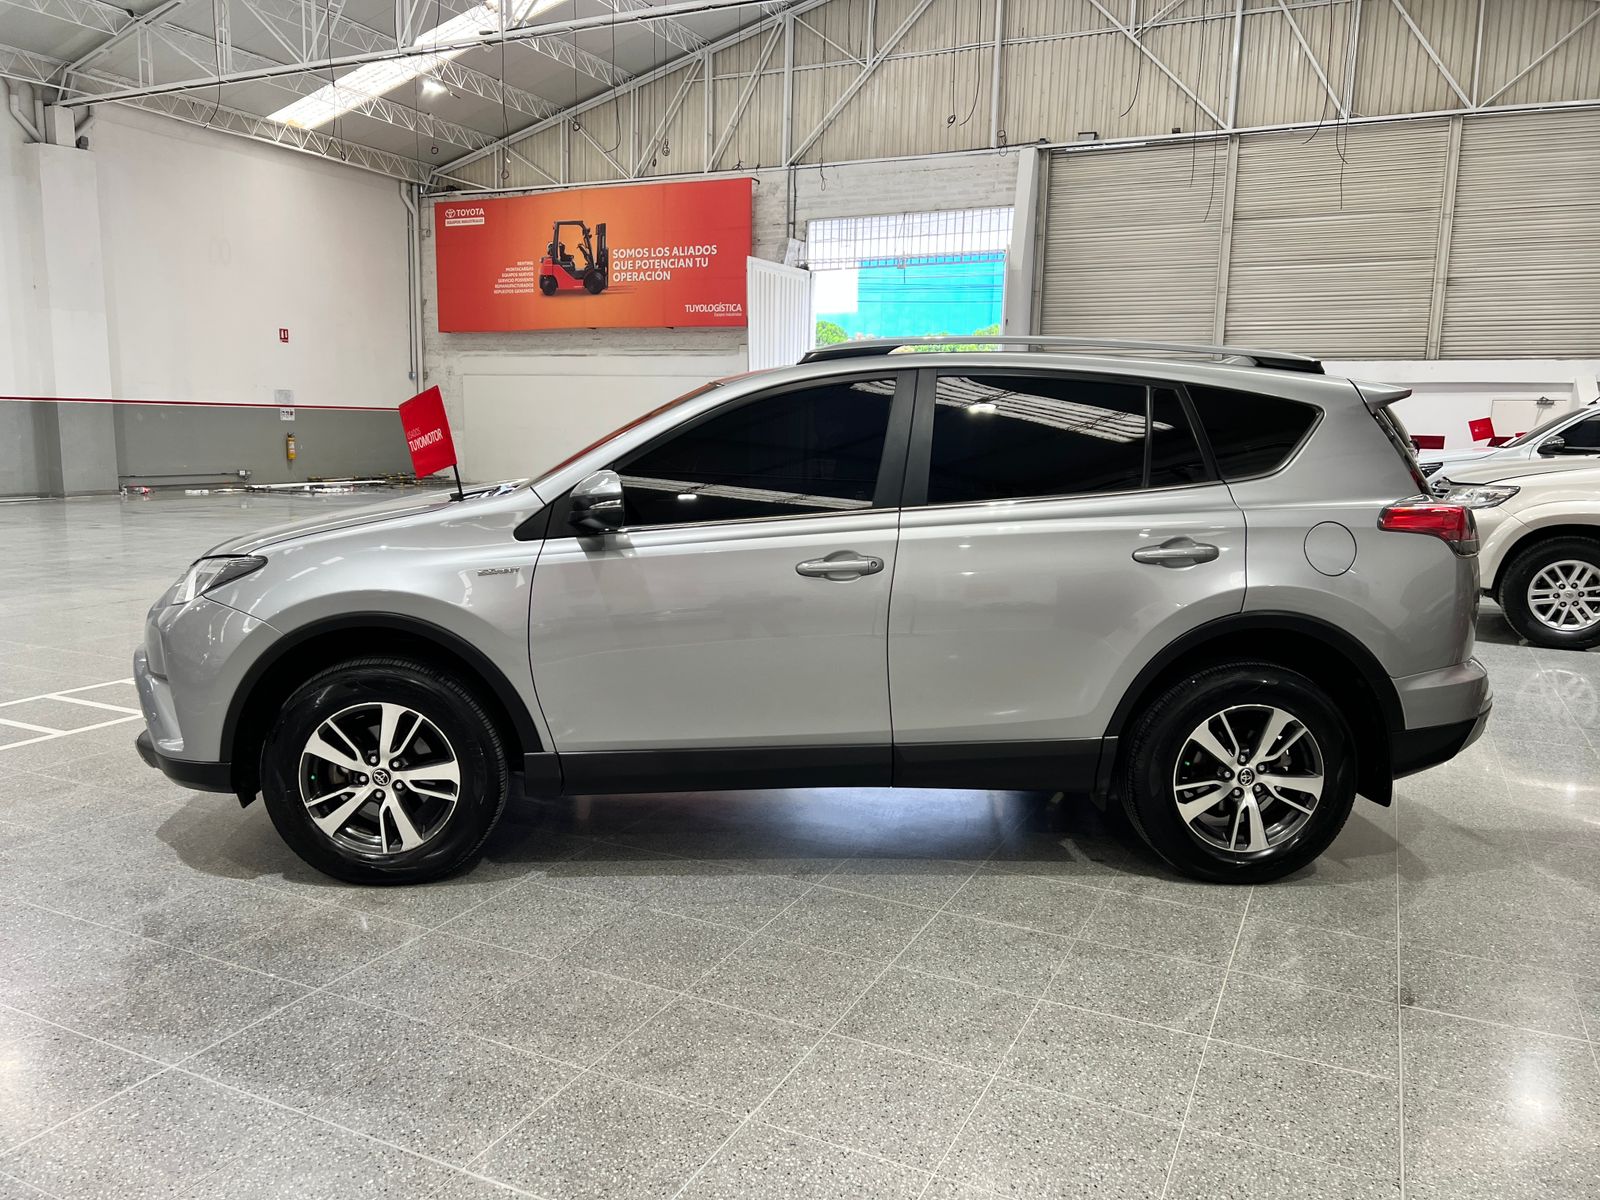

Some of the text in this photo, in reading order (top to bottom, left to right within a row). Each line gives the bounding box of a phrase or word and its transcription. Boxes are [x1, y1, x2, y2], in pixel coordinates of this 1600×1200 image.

[456, 208, 485, 216] TOYOTA
[612, 245, 718, 258] SOMOS LOS ALIADOS
[612, 257, 709, 271] QUE POTENCIAN TU
[612, 269, 671, 282] OPERACIÓN
[684, 302, 742, 312] TUYOLOGÍSTICA
[409, 428, 443, 452] TUYOMOTOR
